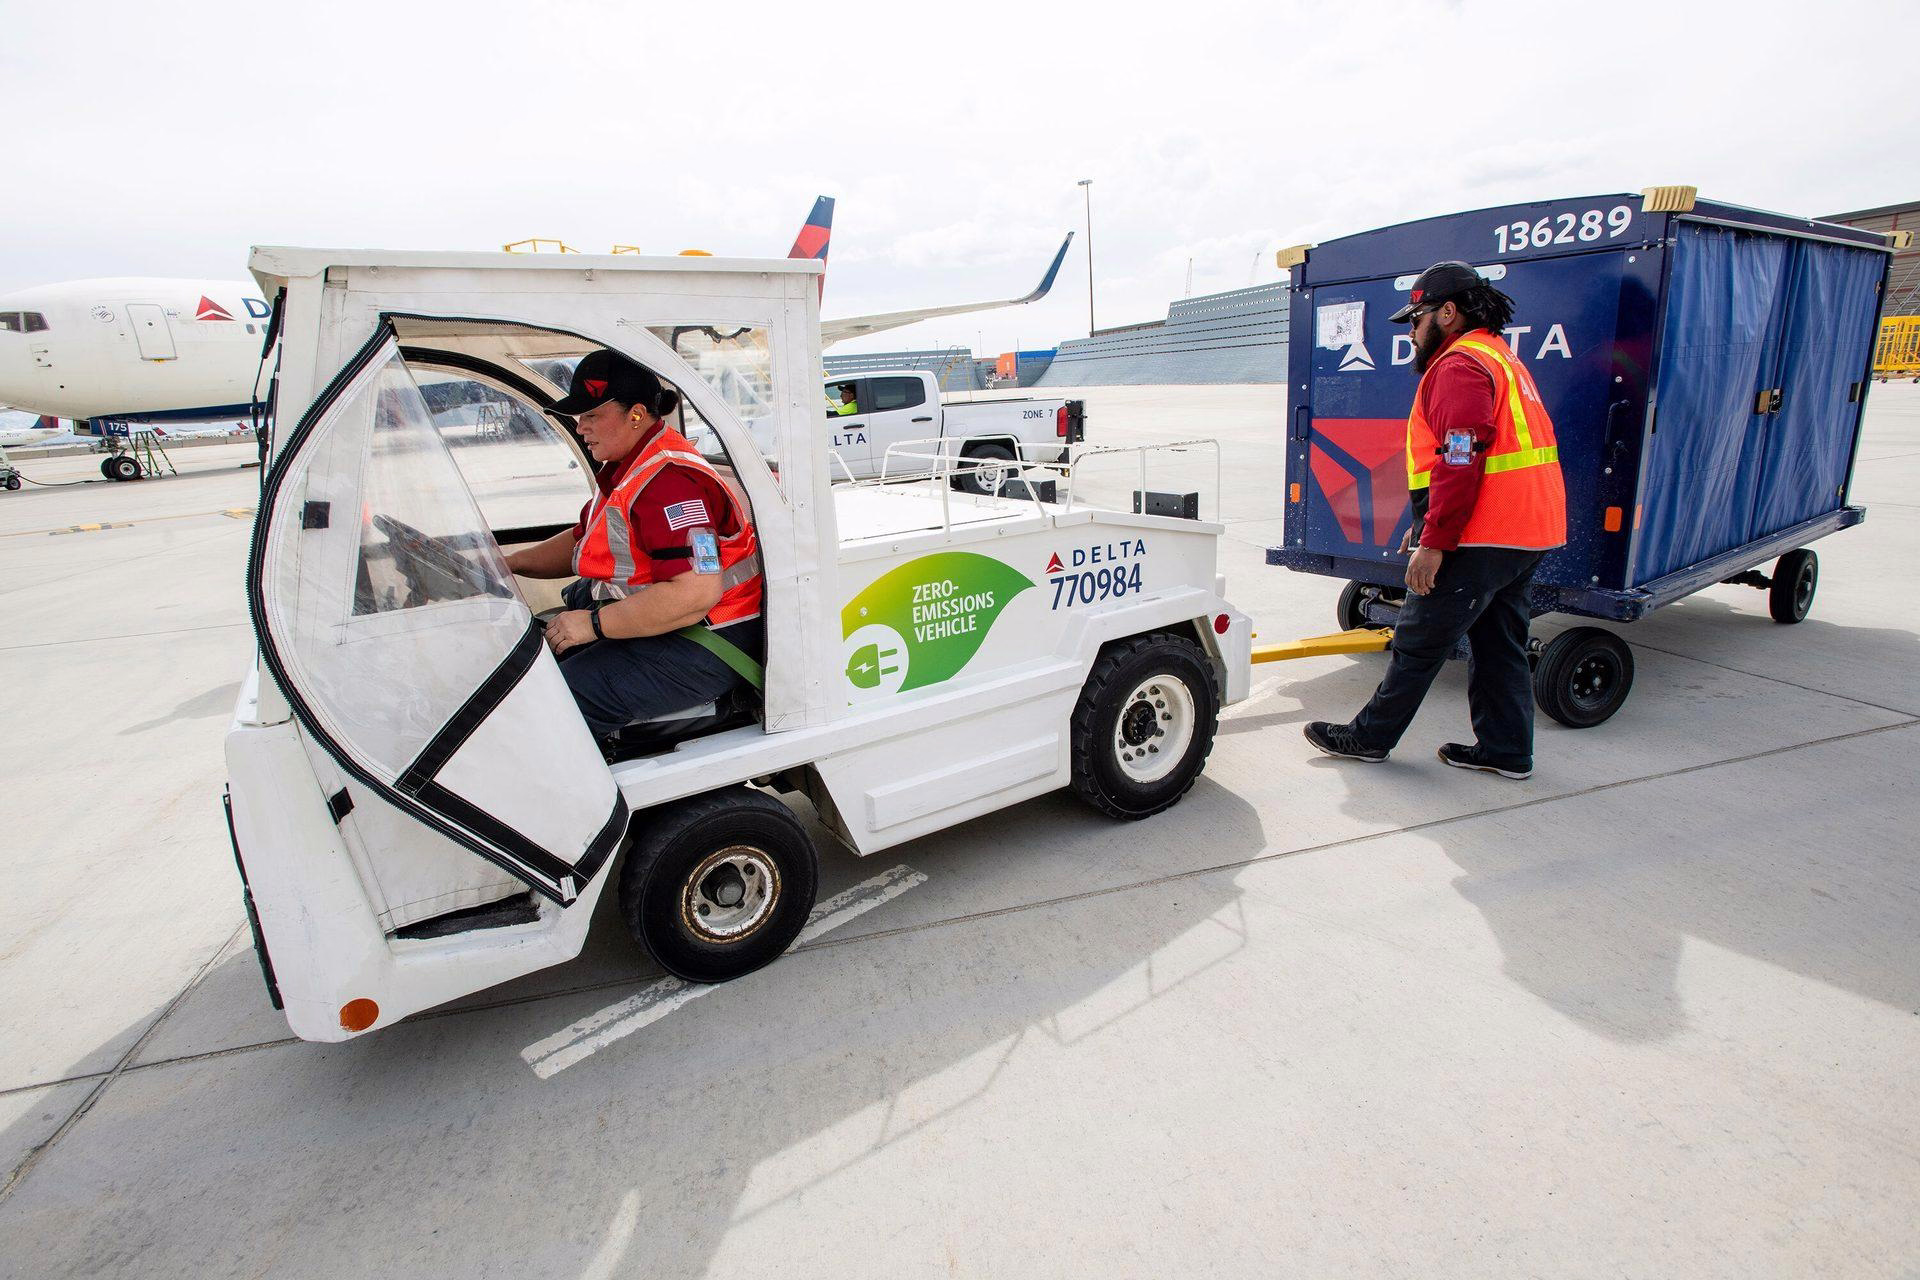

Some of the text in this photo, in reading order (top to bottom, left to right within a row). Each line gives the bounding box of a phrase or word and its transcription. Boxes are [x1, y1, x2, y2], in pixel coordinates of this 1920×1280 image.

[1494, 205, 1632, 254] 136289
[1391, 324, 1572, 366] DTA
[108, 422, 127, 432] 175
[1023, 409, 1053, 419] ZONE 7
[834, 432, 867, 446] LTA
[1072, 539, 1147, 567] DELTA
[912, 580, 960, 604] ZERO-
[1050, 563, 1143, 611] 770984
[912, 591, 995, 625] EMISSIONS
[914, 614, 978, 643] VEHICLE
